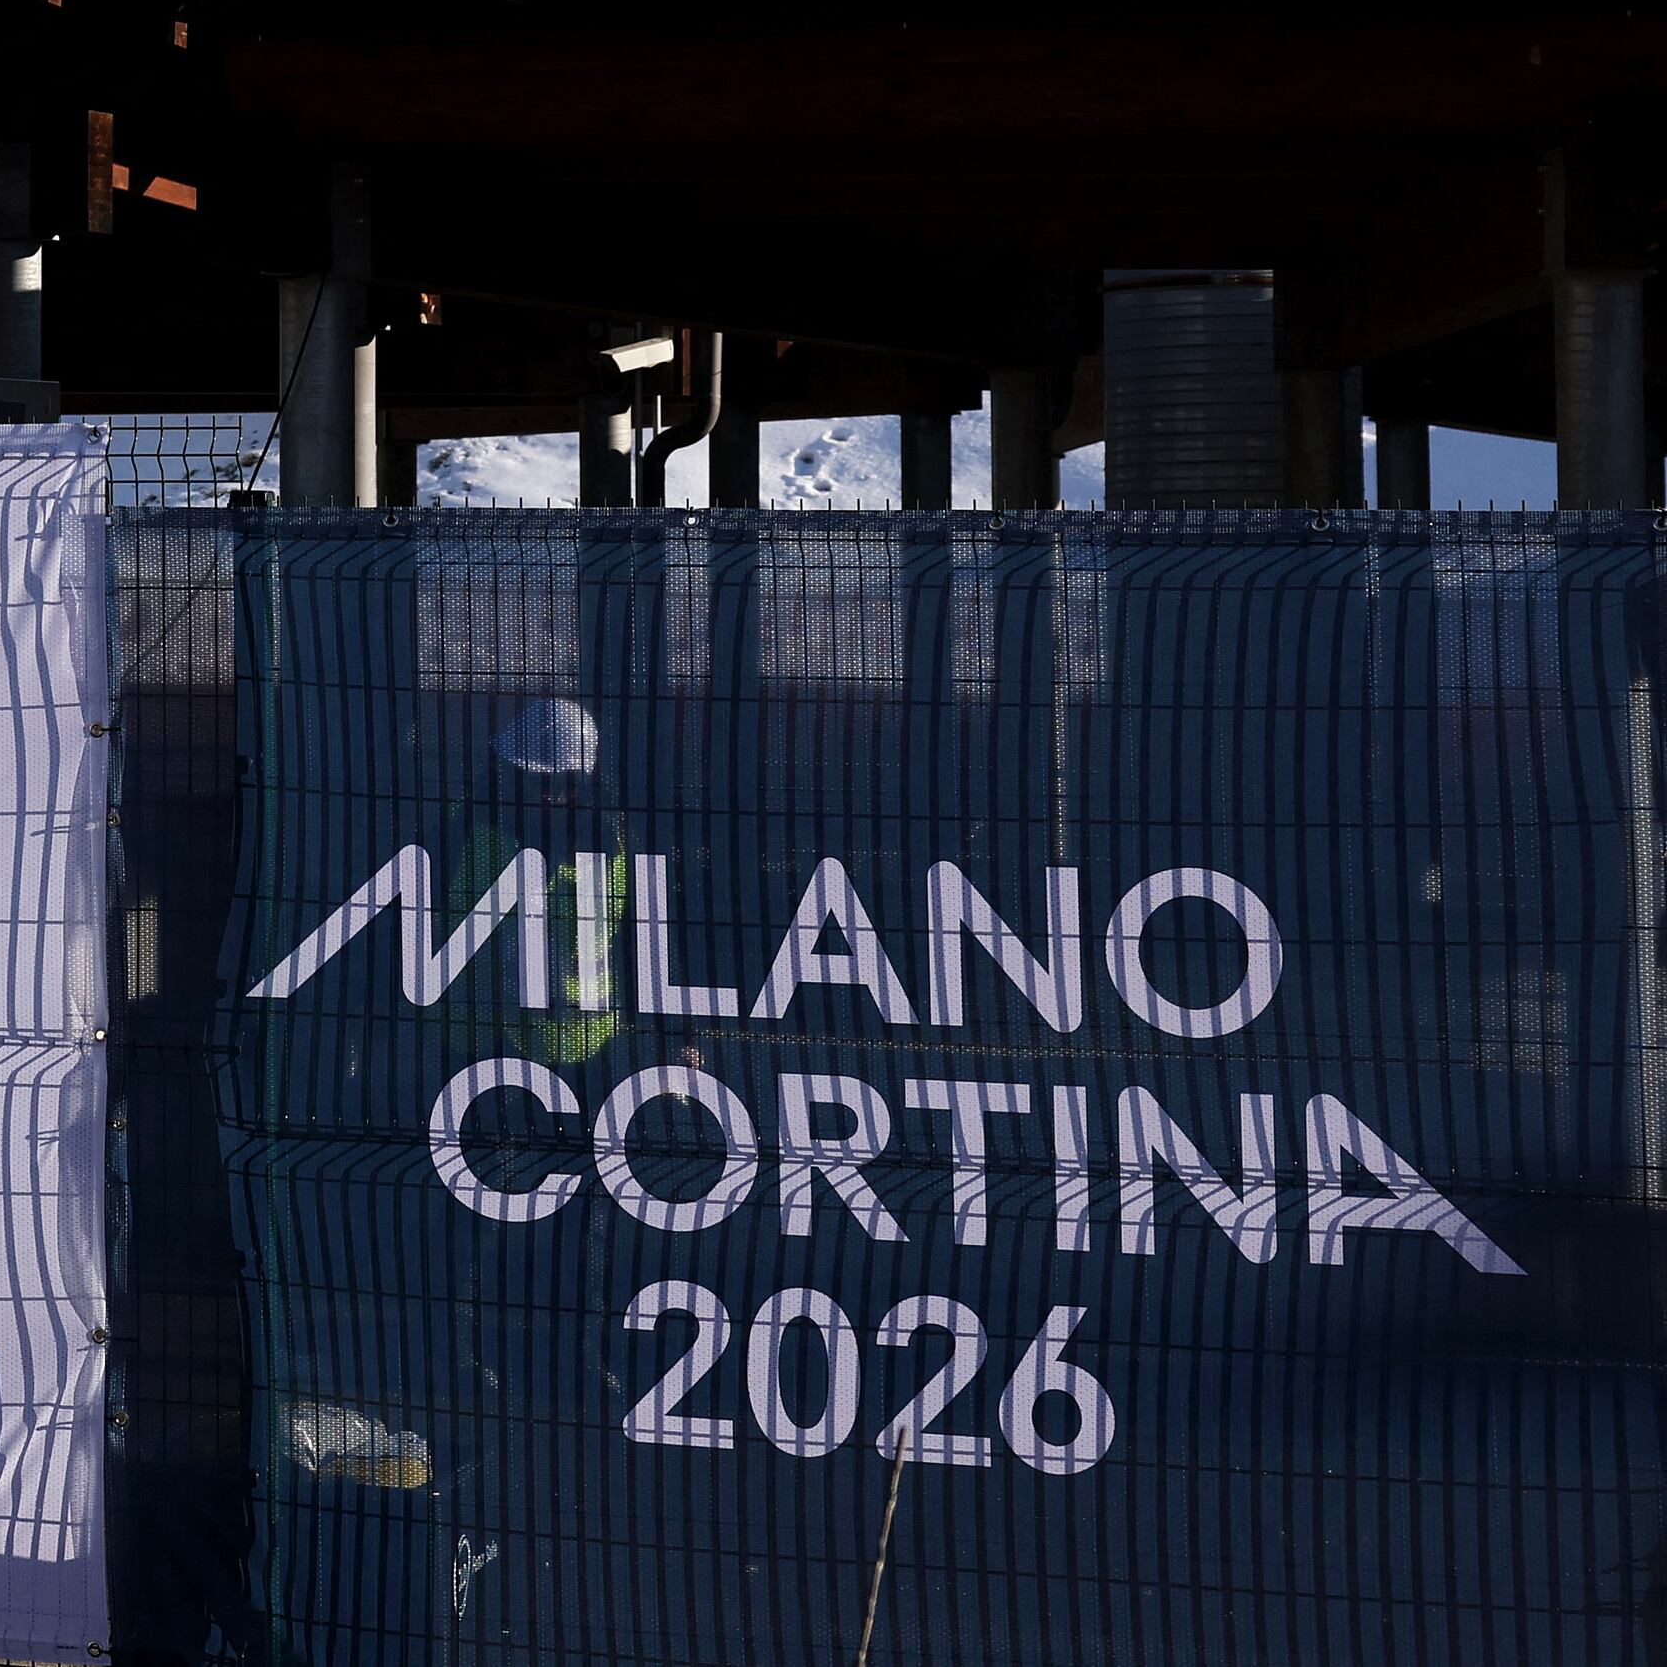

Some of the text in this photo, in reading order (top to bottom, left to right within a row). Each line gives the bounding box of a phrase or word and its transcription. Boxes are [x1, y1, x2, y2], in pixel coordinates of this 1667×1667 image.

[245, 843, 1283, 1039] MILANO
[428, 1057, 1528, 1276] CORTINA
[621, 1279, 1115, 1476] 2026
